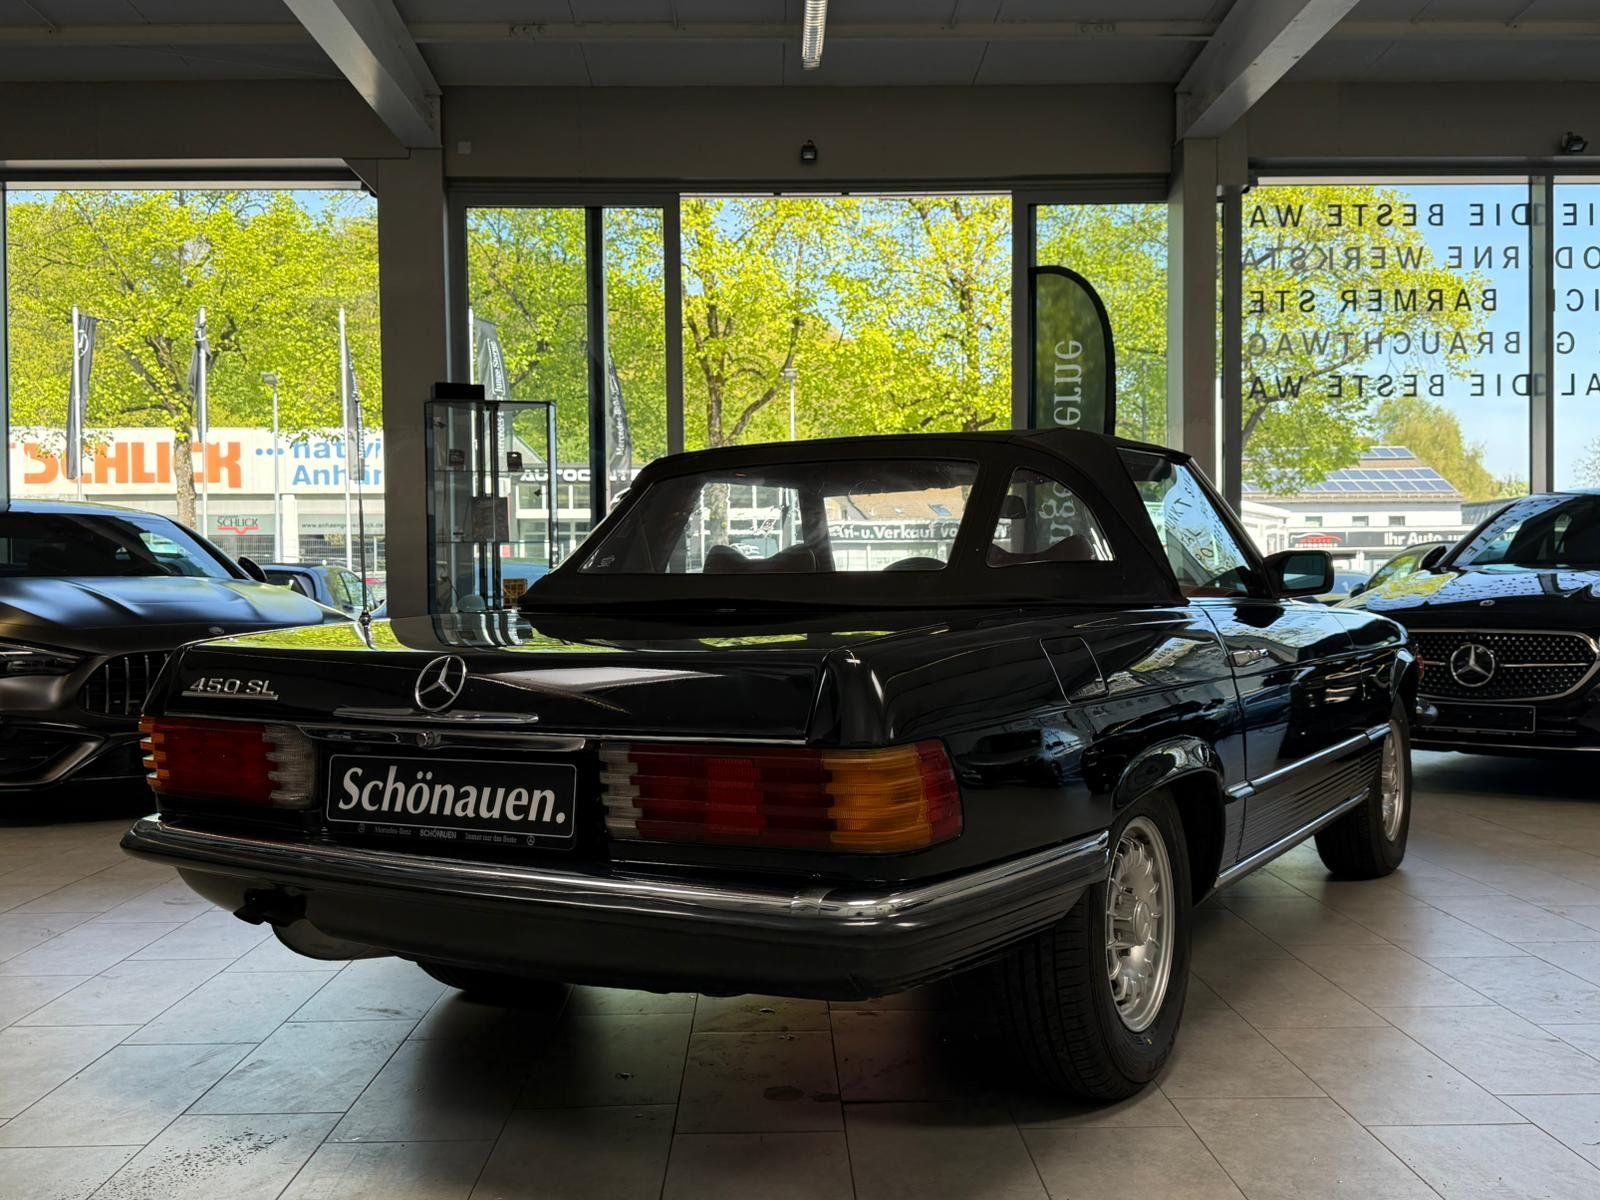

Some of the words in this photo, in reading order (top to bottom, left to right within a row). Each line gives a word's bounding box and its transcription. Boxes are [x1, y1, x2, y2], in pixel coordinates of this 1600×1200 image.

[1384, 532, 1406, 546] Ihr
[190, 677, 241, 694] 450
[245, 679, 275, 695] SL
[338, 765, 566, 824] Schönauen.
